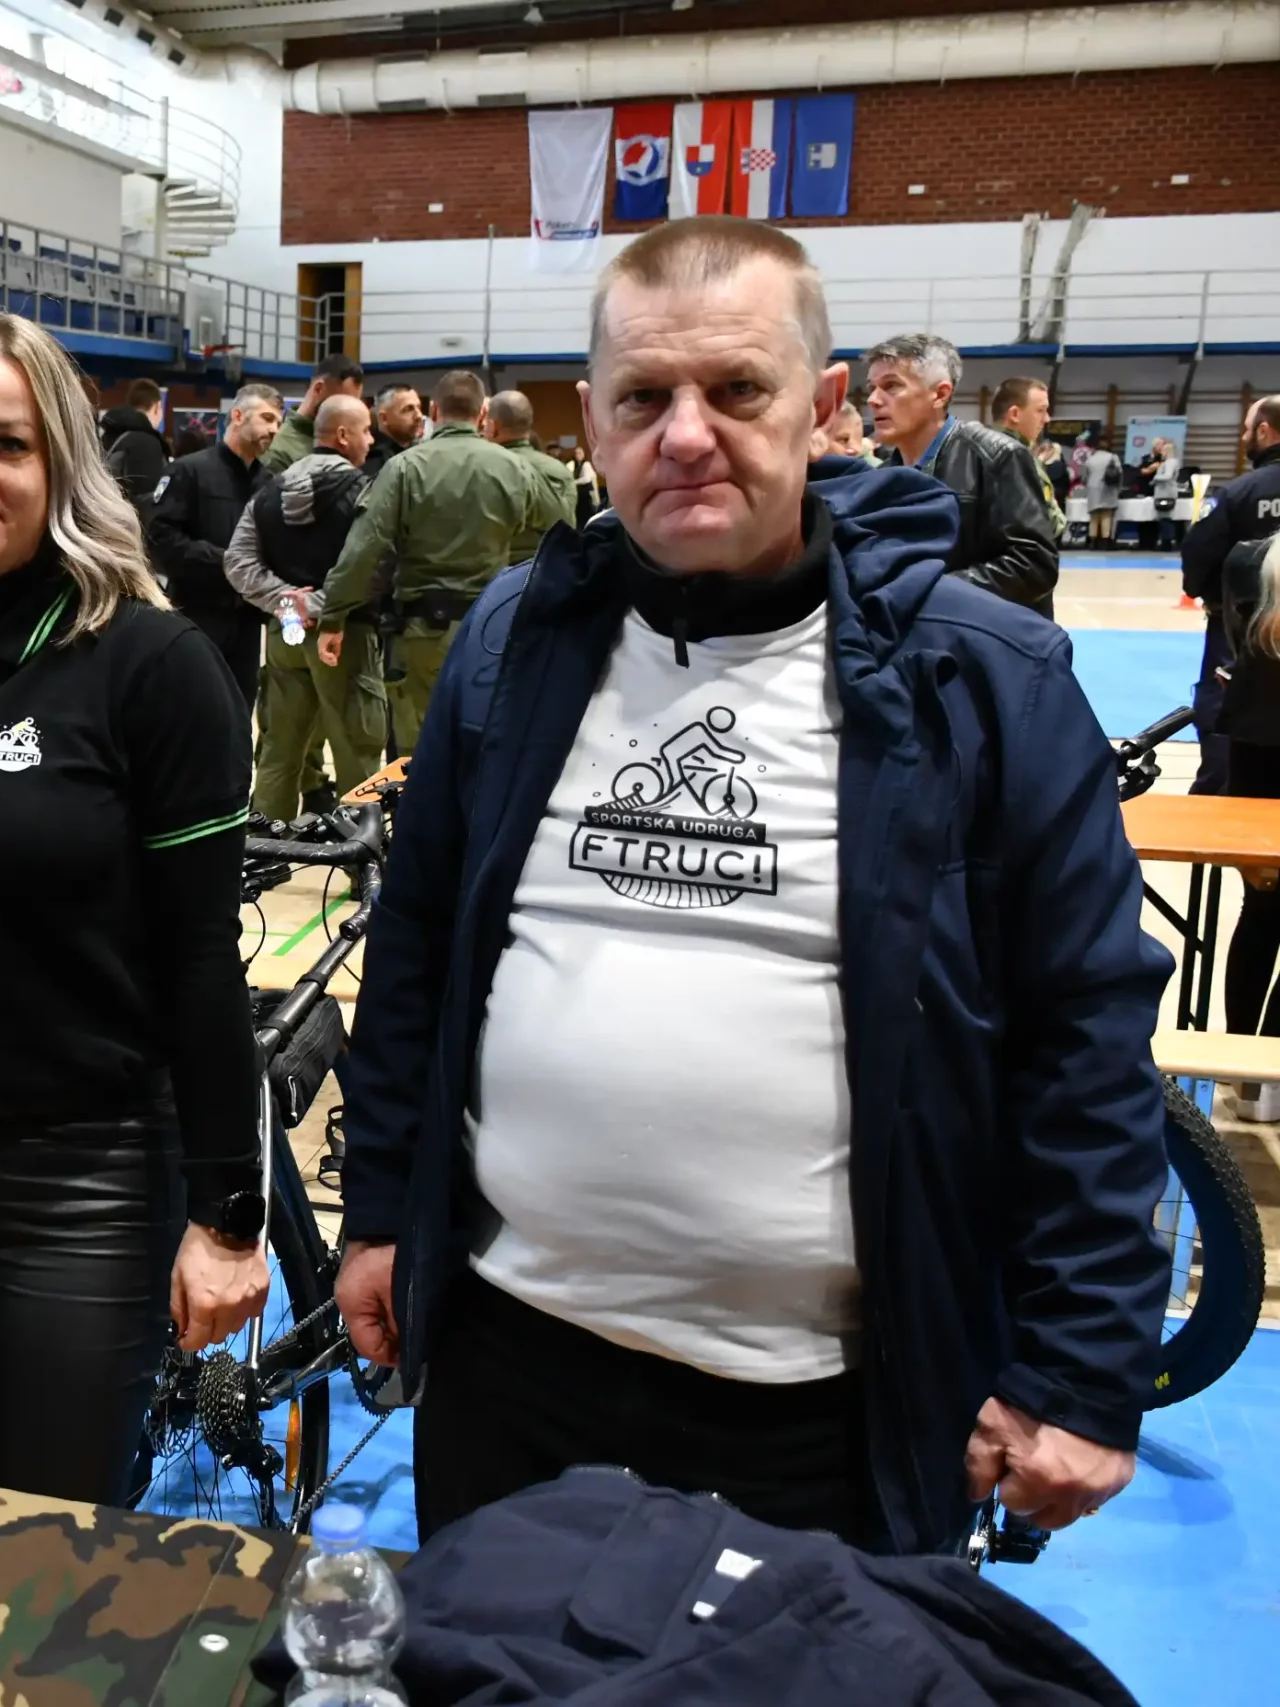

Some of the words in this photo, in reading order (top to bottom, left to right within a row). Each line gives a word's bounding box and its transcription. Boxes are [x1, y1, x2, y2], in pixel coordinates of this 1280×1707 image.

[591, 812, 675, 830] SPORTSKA
[682, 820, 757, 839] UDRUGA
[582, 834, 761, 884] FTRUC!
